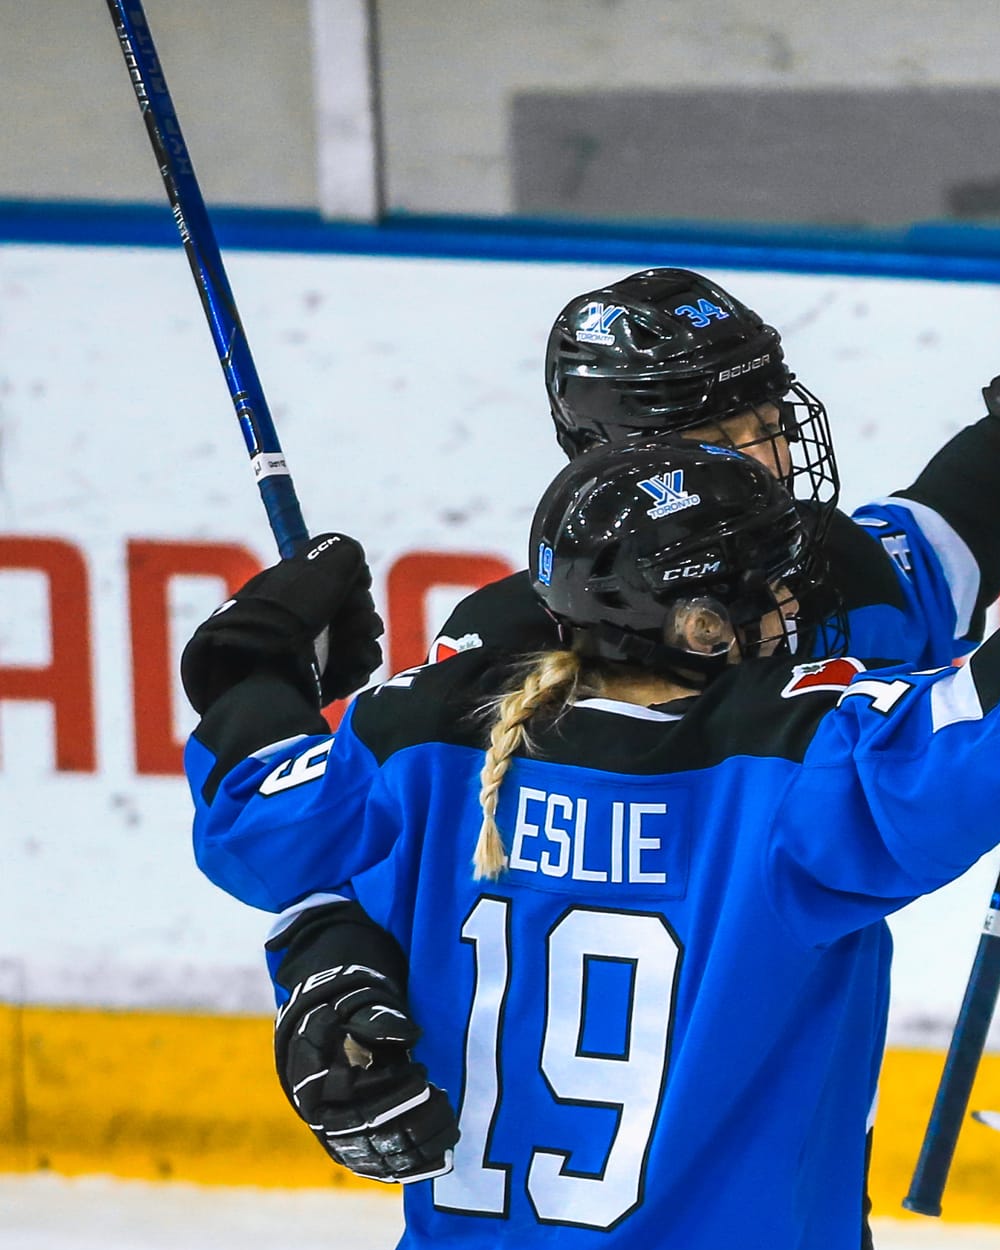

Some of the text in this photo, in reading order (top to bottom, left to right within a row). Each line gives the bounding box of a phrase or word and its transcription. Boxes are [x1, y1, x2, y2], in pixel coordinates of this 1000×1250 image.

[674, 298, 730, 328] 34
[576, 331, 615, 345] TORONTO
[718, 353, 772, 383] BAUER
[647, 495, 700, 519] TORONTO
[307, 535, 341, 561] CCM
[537, 541, 555, 587] 19
[661, 559, 722, 582] CCM
[505, 786, 667, 884] ESLIE
[432, 894, 685, 1232] 19
